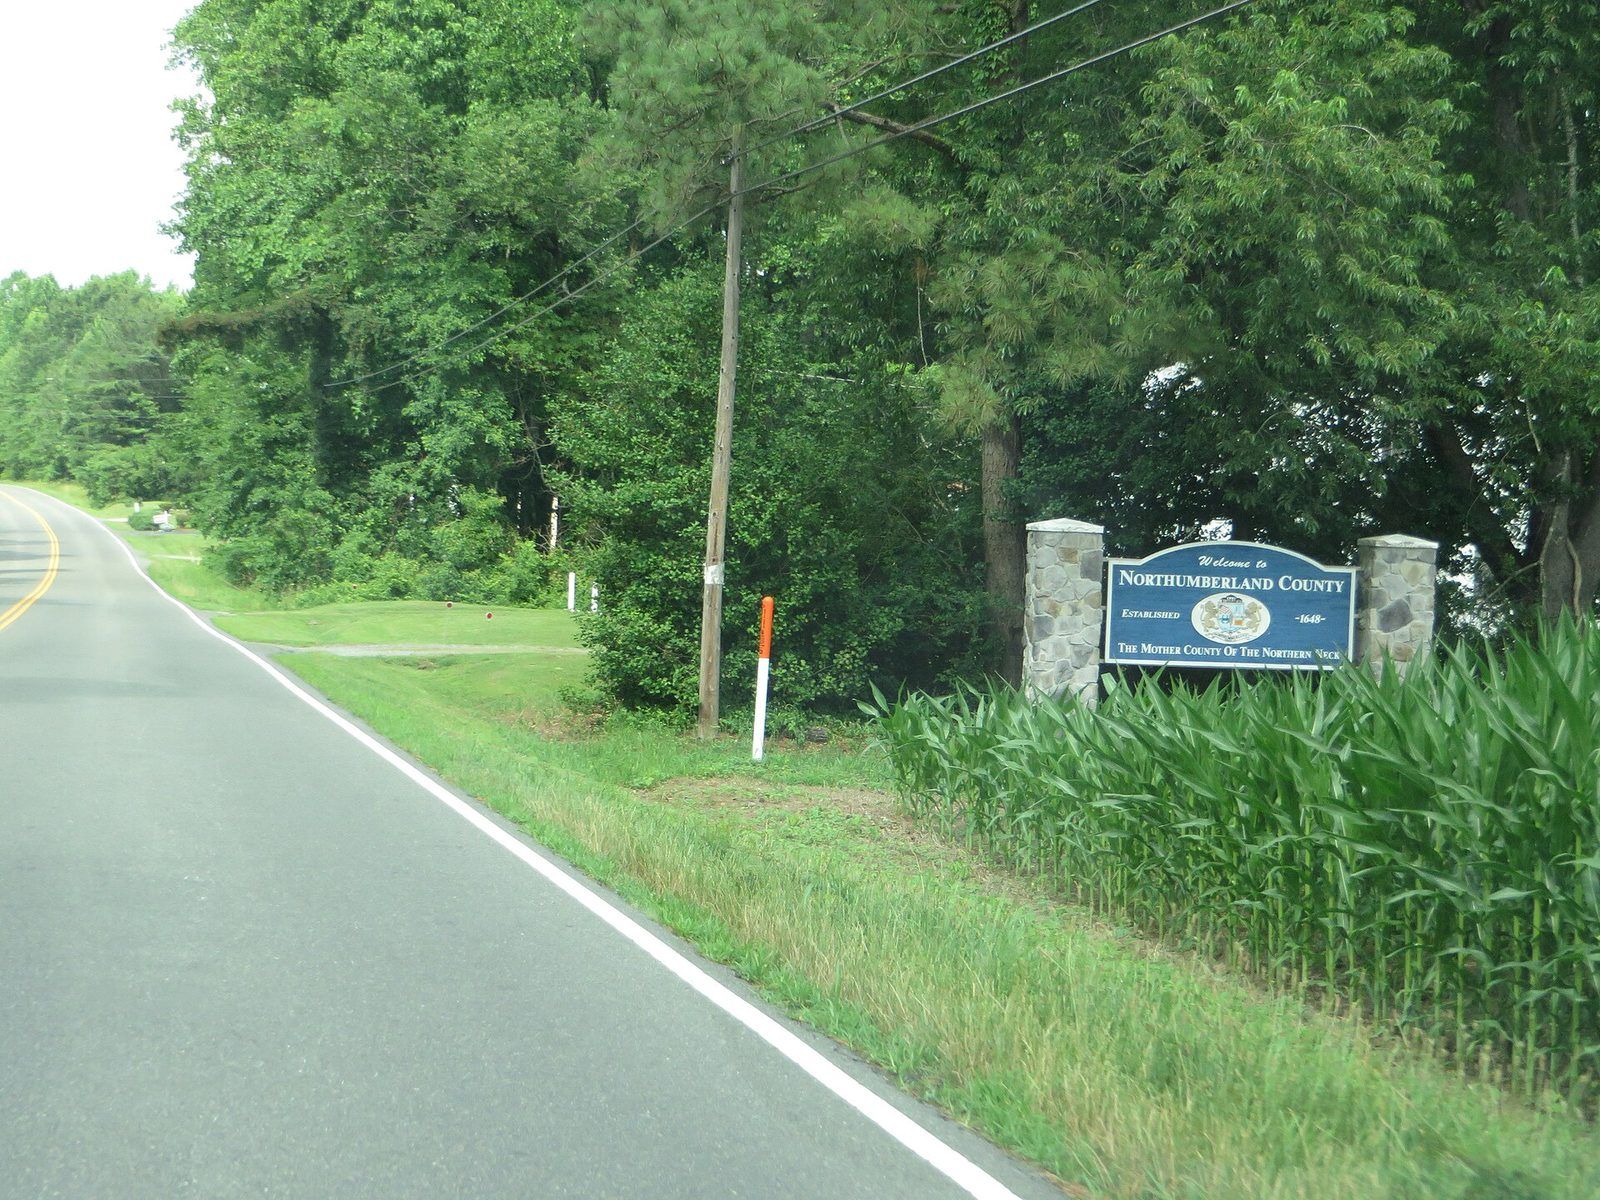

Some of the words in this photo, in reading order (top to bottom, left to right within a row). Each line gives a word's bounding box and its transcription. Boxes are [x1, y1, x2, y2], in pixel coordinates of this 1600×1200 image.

[1198, 555, 1251, 568] Welcome
[1256, 559, 1267, 568] to
[1119, 570, 1273, 590] NORTHUMBERLAND
[1278, 575, 1344, 593] COUNTY
[1122, 609, 1180, 619] ESTABLISHED
[1294, 614, 1326, 624] -1648-
[1118, 642, 1137, 654] THE
[1141, 644, 1181, 654] MOTHER
[1183, 645, 1221, 656] COUNTY
[1223, 646, 1237, 656] OF
[1240, 646, 1260, 657] THE
[1262, 647, 1312, 659] NORTHERN
